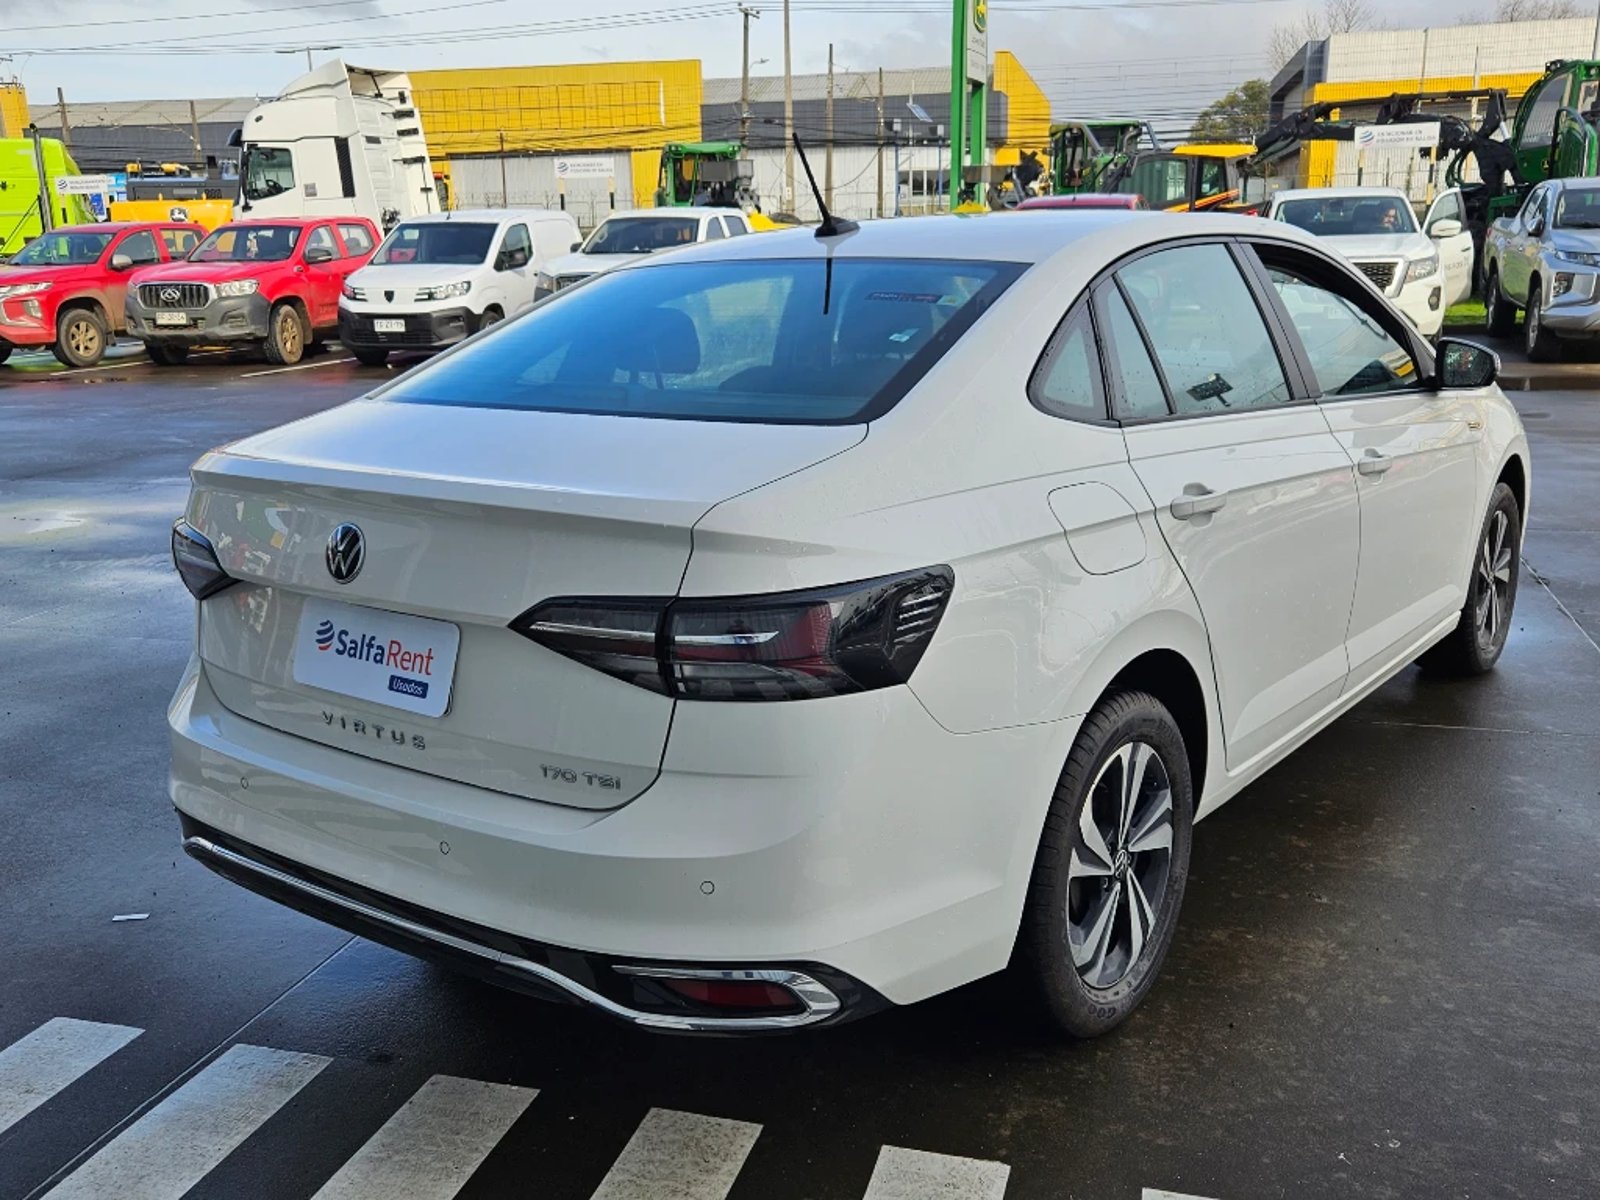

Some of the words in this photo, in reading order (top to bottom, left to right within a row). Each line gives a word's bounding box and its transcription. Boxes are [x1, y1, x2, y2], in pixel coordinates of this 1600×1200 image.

[335, 629, 434, 676] SalfaRent
[392, 677, 425, 696] Usados
[322, 710, 426, 750] VIRTUS
[539, 763, 578, 783] 170
